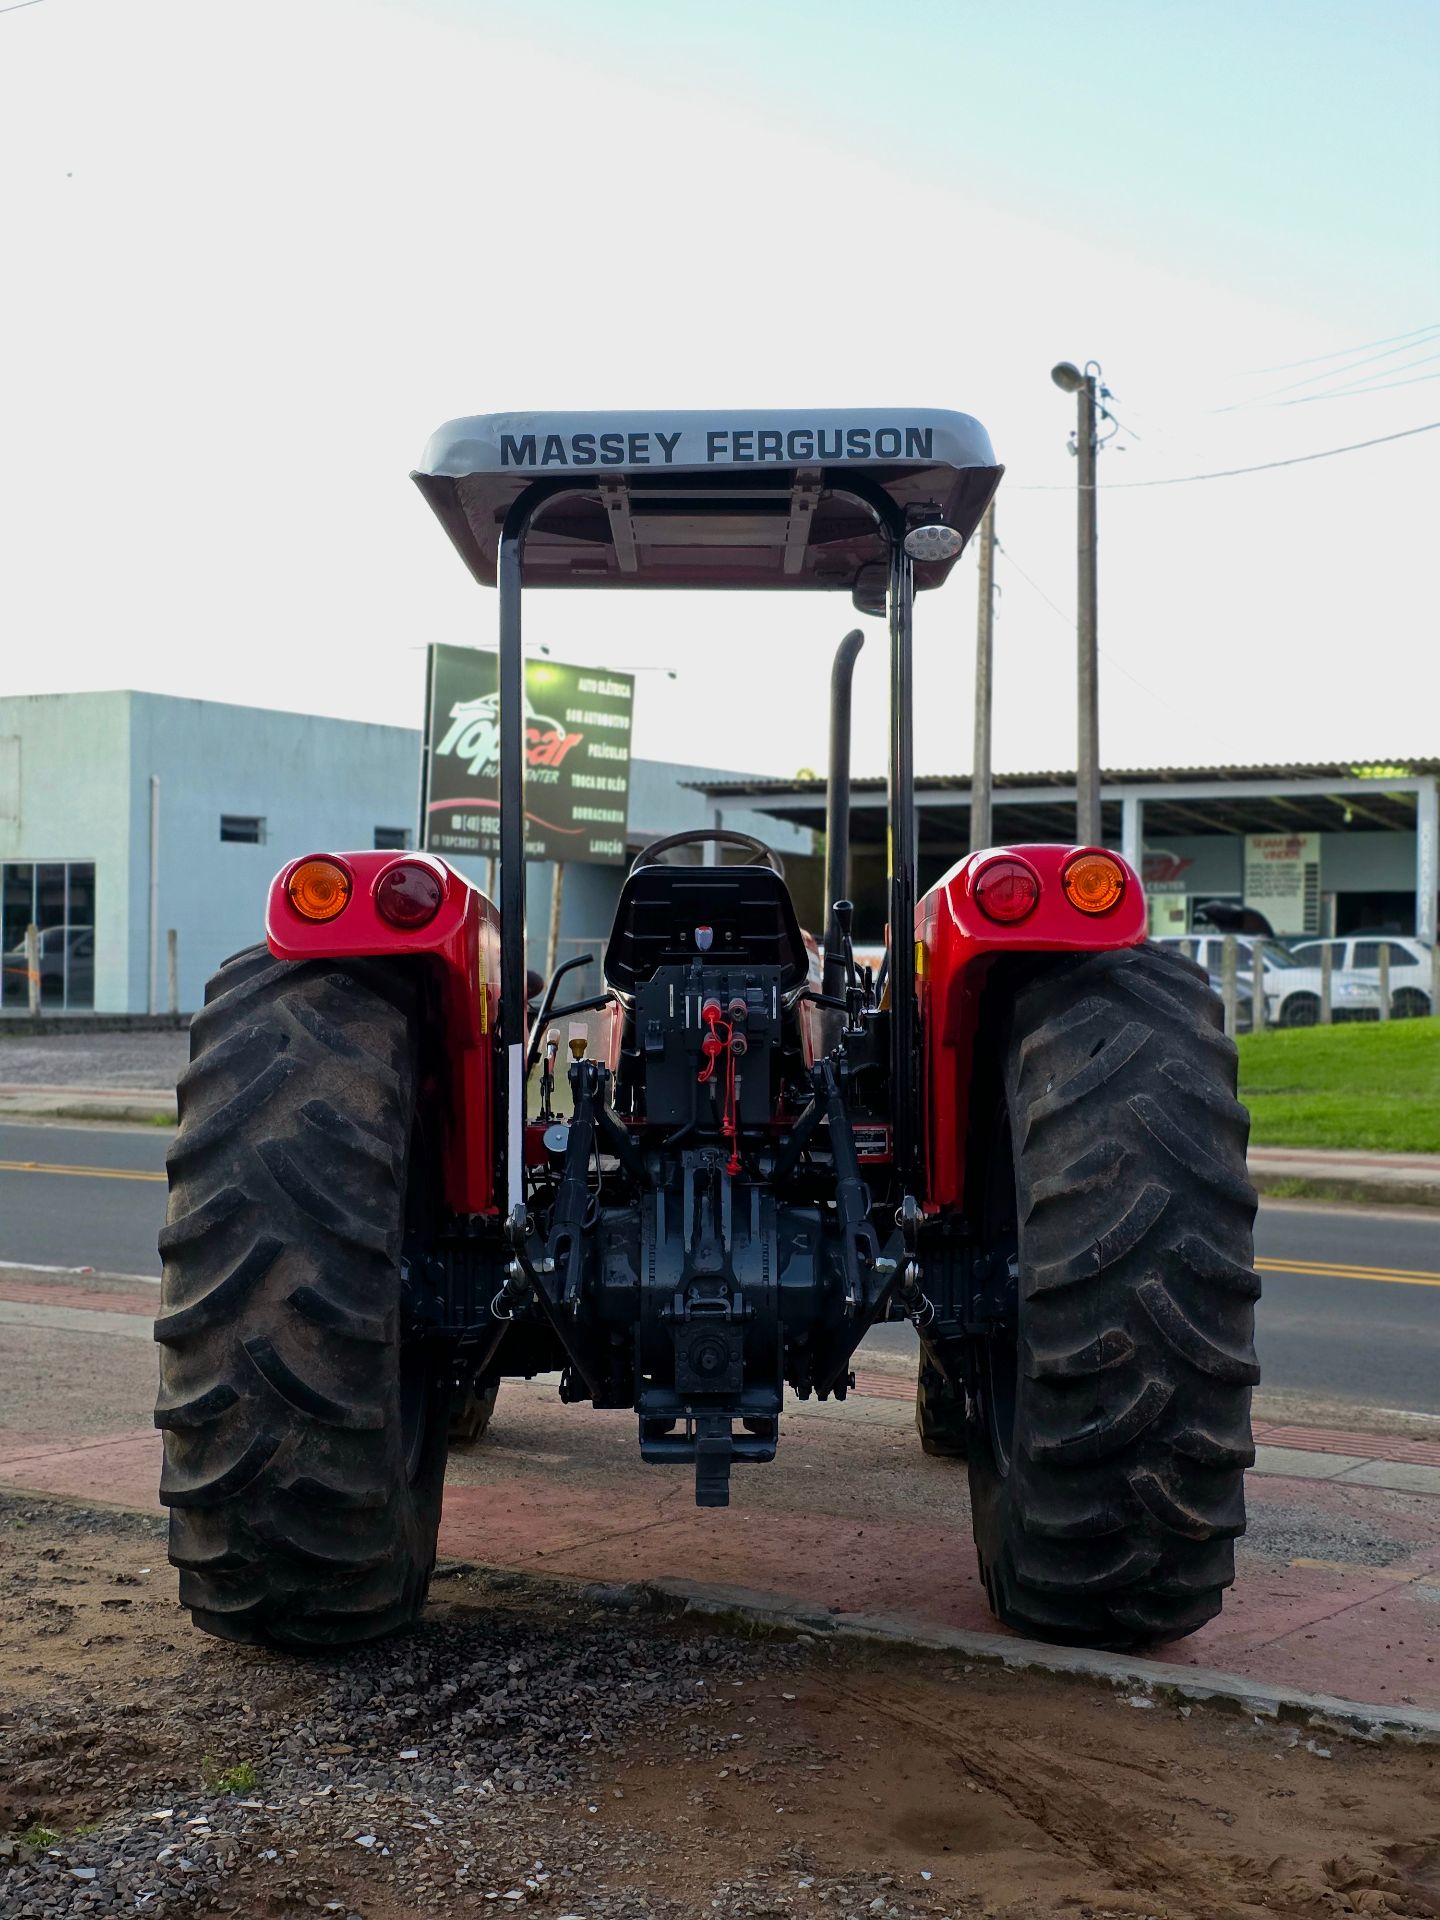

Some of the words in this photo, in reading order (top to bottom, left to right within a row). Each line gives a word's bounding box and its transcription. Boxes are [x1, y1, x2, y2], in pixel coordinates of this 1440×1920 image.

[500, 432, 682, 467] MASSEY
[706, 427, 934, 463] FERGUSON
[577, 677, 597, 694] AUTO
[583, 710, 630, 730] AUTOMOTIVO
[588, 742, 628, 761] PELÍCULAS
[571, 773, 596, 789] TROCA
[590, 838, 623, 857] LAVAÇÃO
